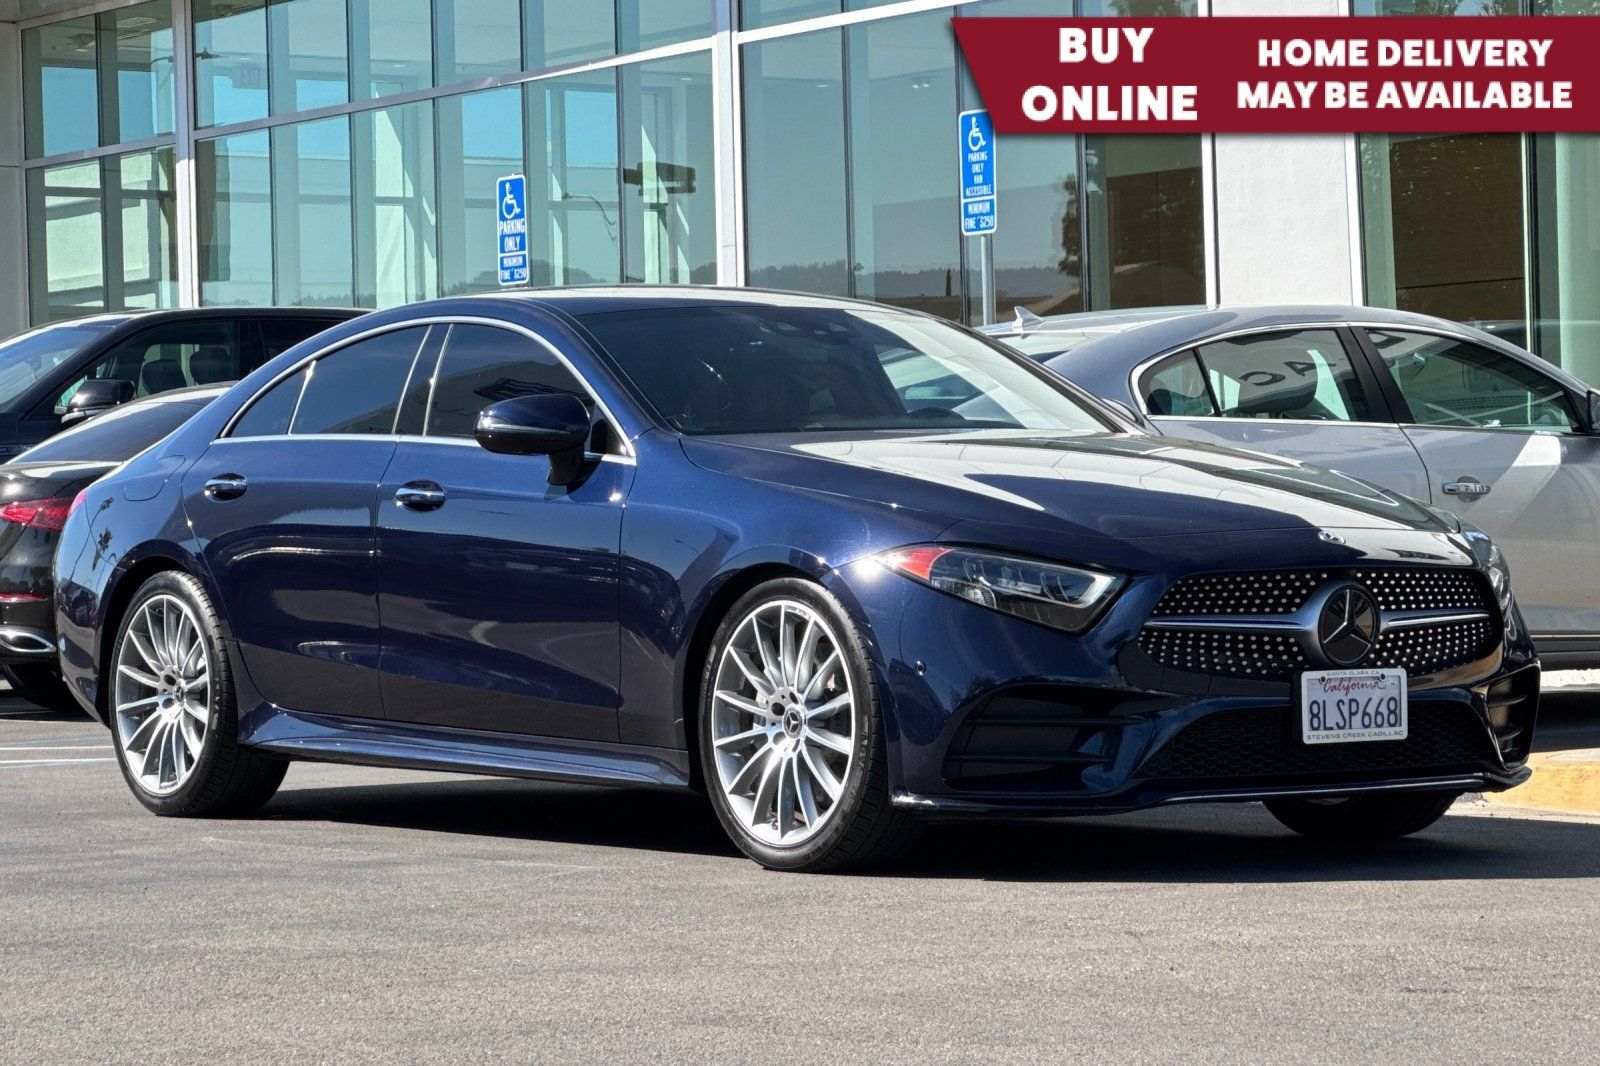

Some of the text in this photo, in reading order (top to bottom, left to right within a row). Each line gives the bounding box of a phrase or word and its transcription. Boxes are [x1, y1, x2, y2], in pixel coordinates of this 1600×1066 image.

[968, 151, 988, 162] PARKING
[971, 163, 984, 173] ONLY
[965, 184, 992, 197] ACCESSIBLE
[968, 202, 990, 214] MINIMUM
[500, 218, 525, 235] PARKING
[965, 217, 976, 229] FINE
[504, 235, 521, 252] ONLY
[503, 256, 523, 267] MINIMUM
[500, 269, 511, 280] FINE
[1323, 678, 1386, 696] California
[1309, 697, 1398, 731] 8LSP668
[1367, 730, 1404, 738] CADILLAC
